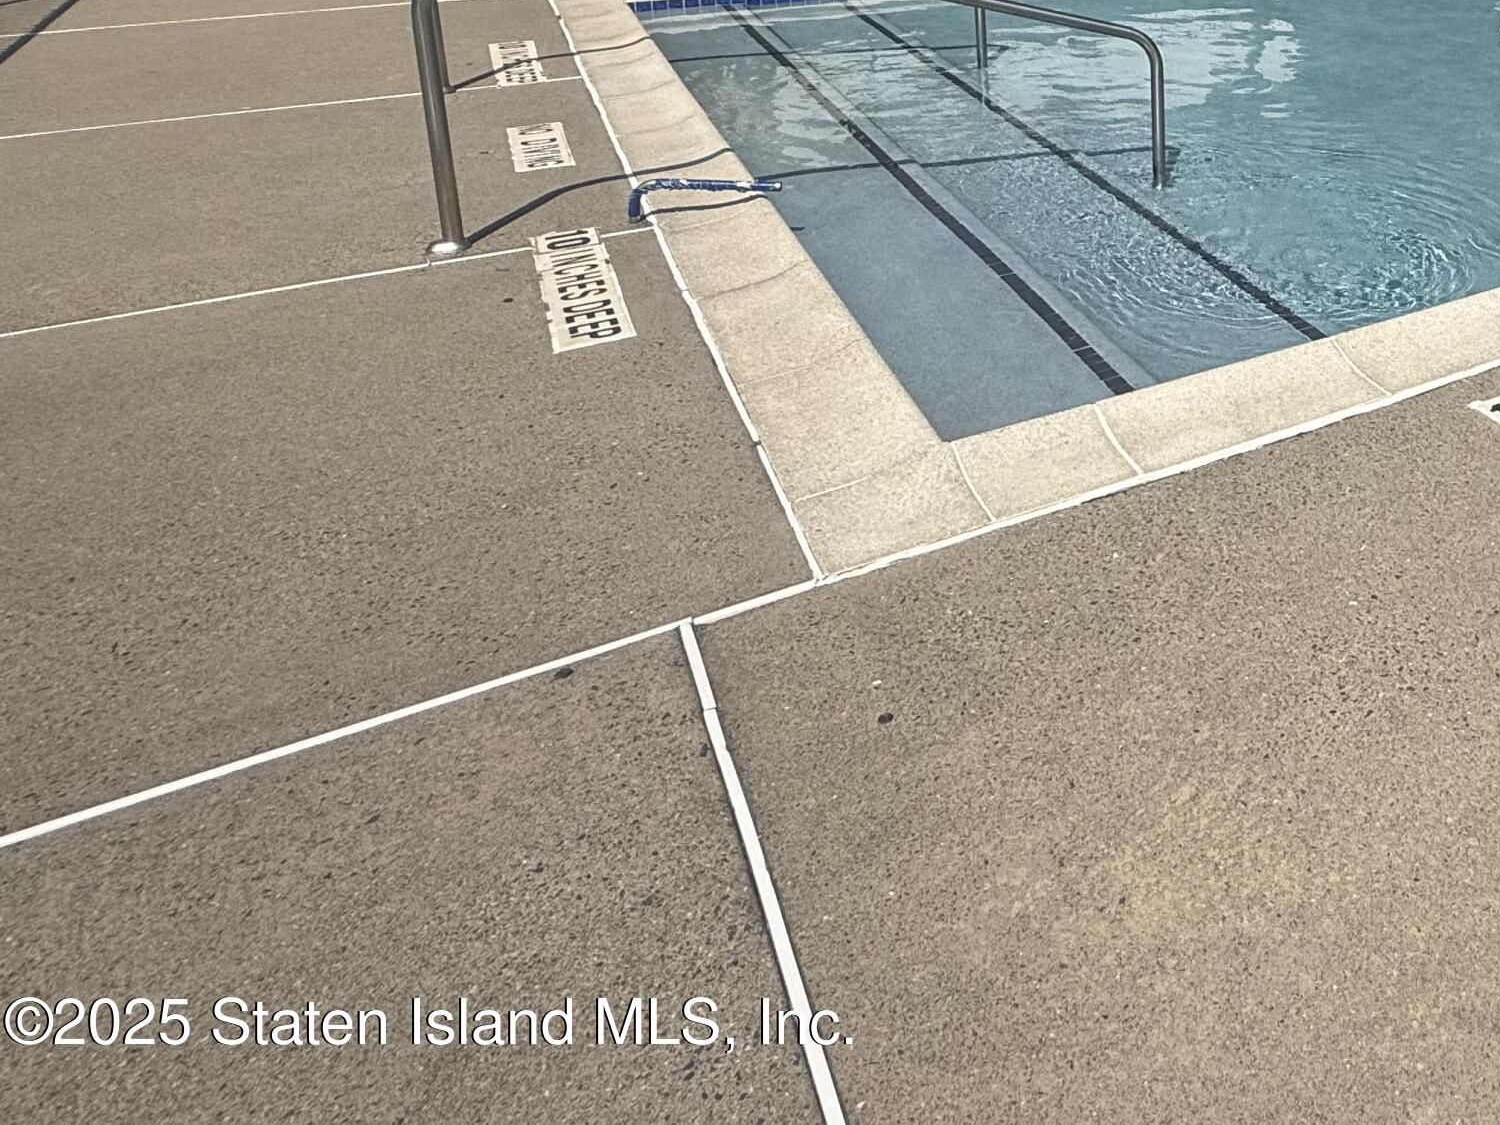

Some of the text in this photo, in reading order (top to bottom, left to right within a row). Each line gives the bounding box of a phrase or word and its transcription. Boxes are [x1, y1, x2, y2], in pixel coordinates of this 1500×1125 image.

[544, 229, 622, 339] 10 INCHES DEEP
